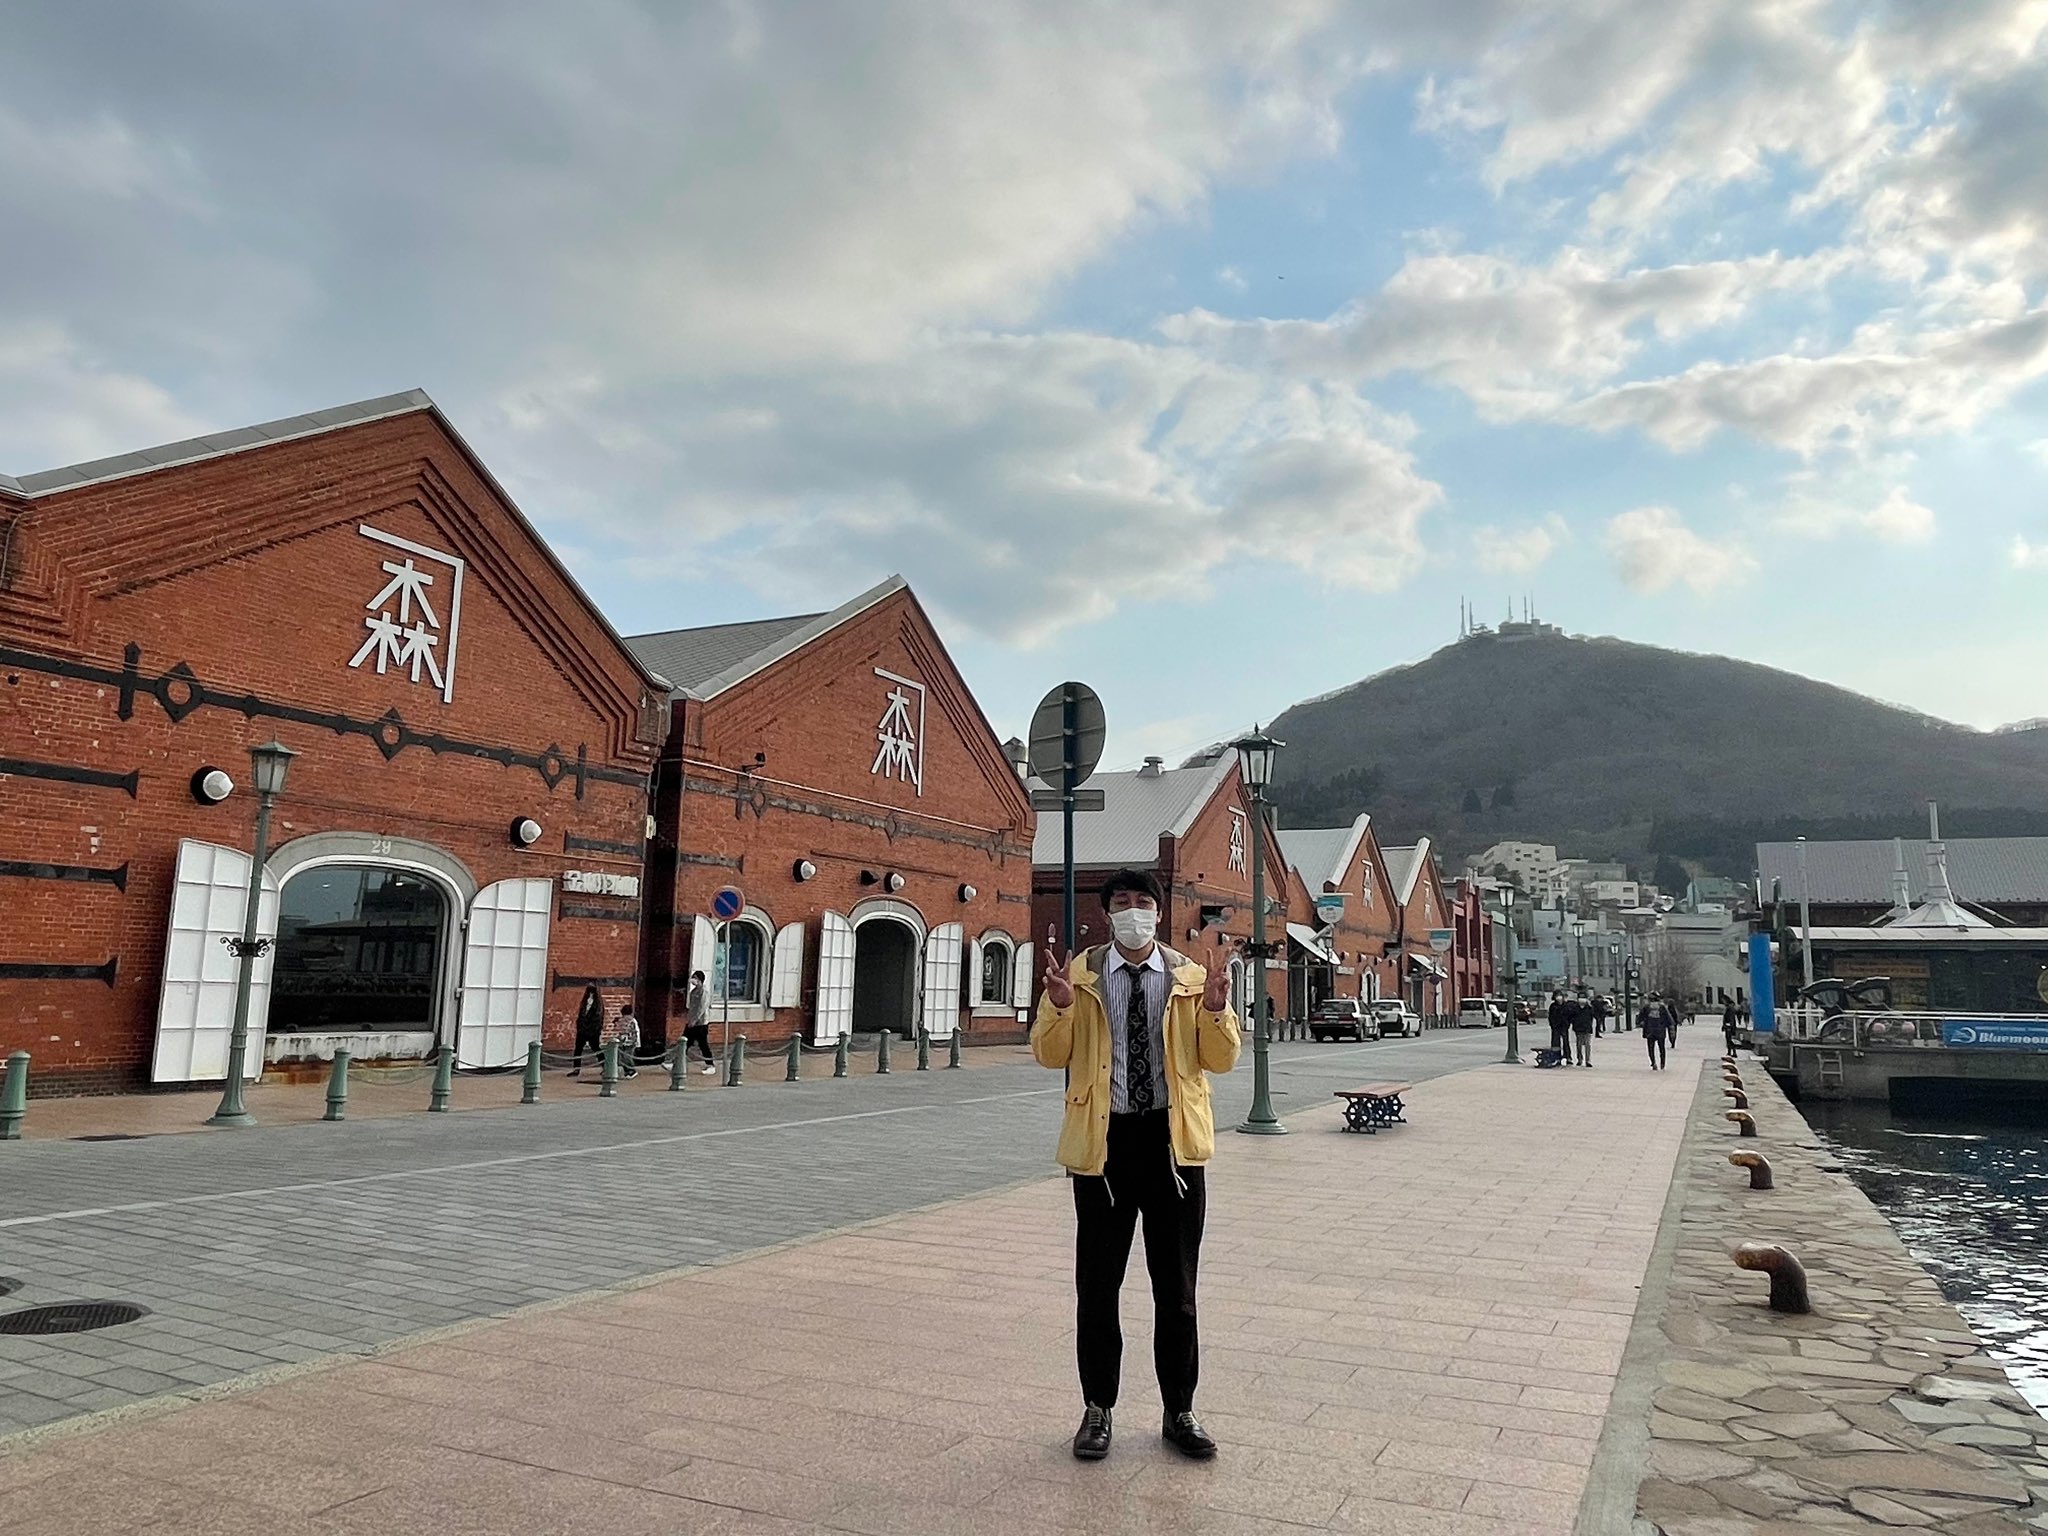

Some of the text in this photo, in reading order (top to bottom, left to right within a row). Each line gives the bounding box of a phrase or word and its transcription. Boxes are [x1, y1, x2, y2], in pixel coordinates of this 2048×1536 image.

[348, 558, 445, 689] 森
[871, 685, 919, 786] 森
[371, 839, 392, 855] 29
